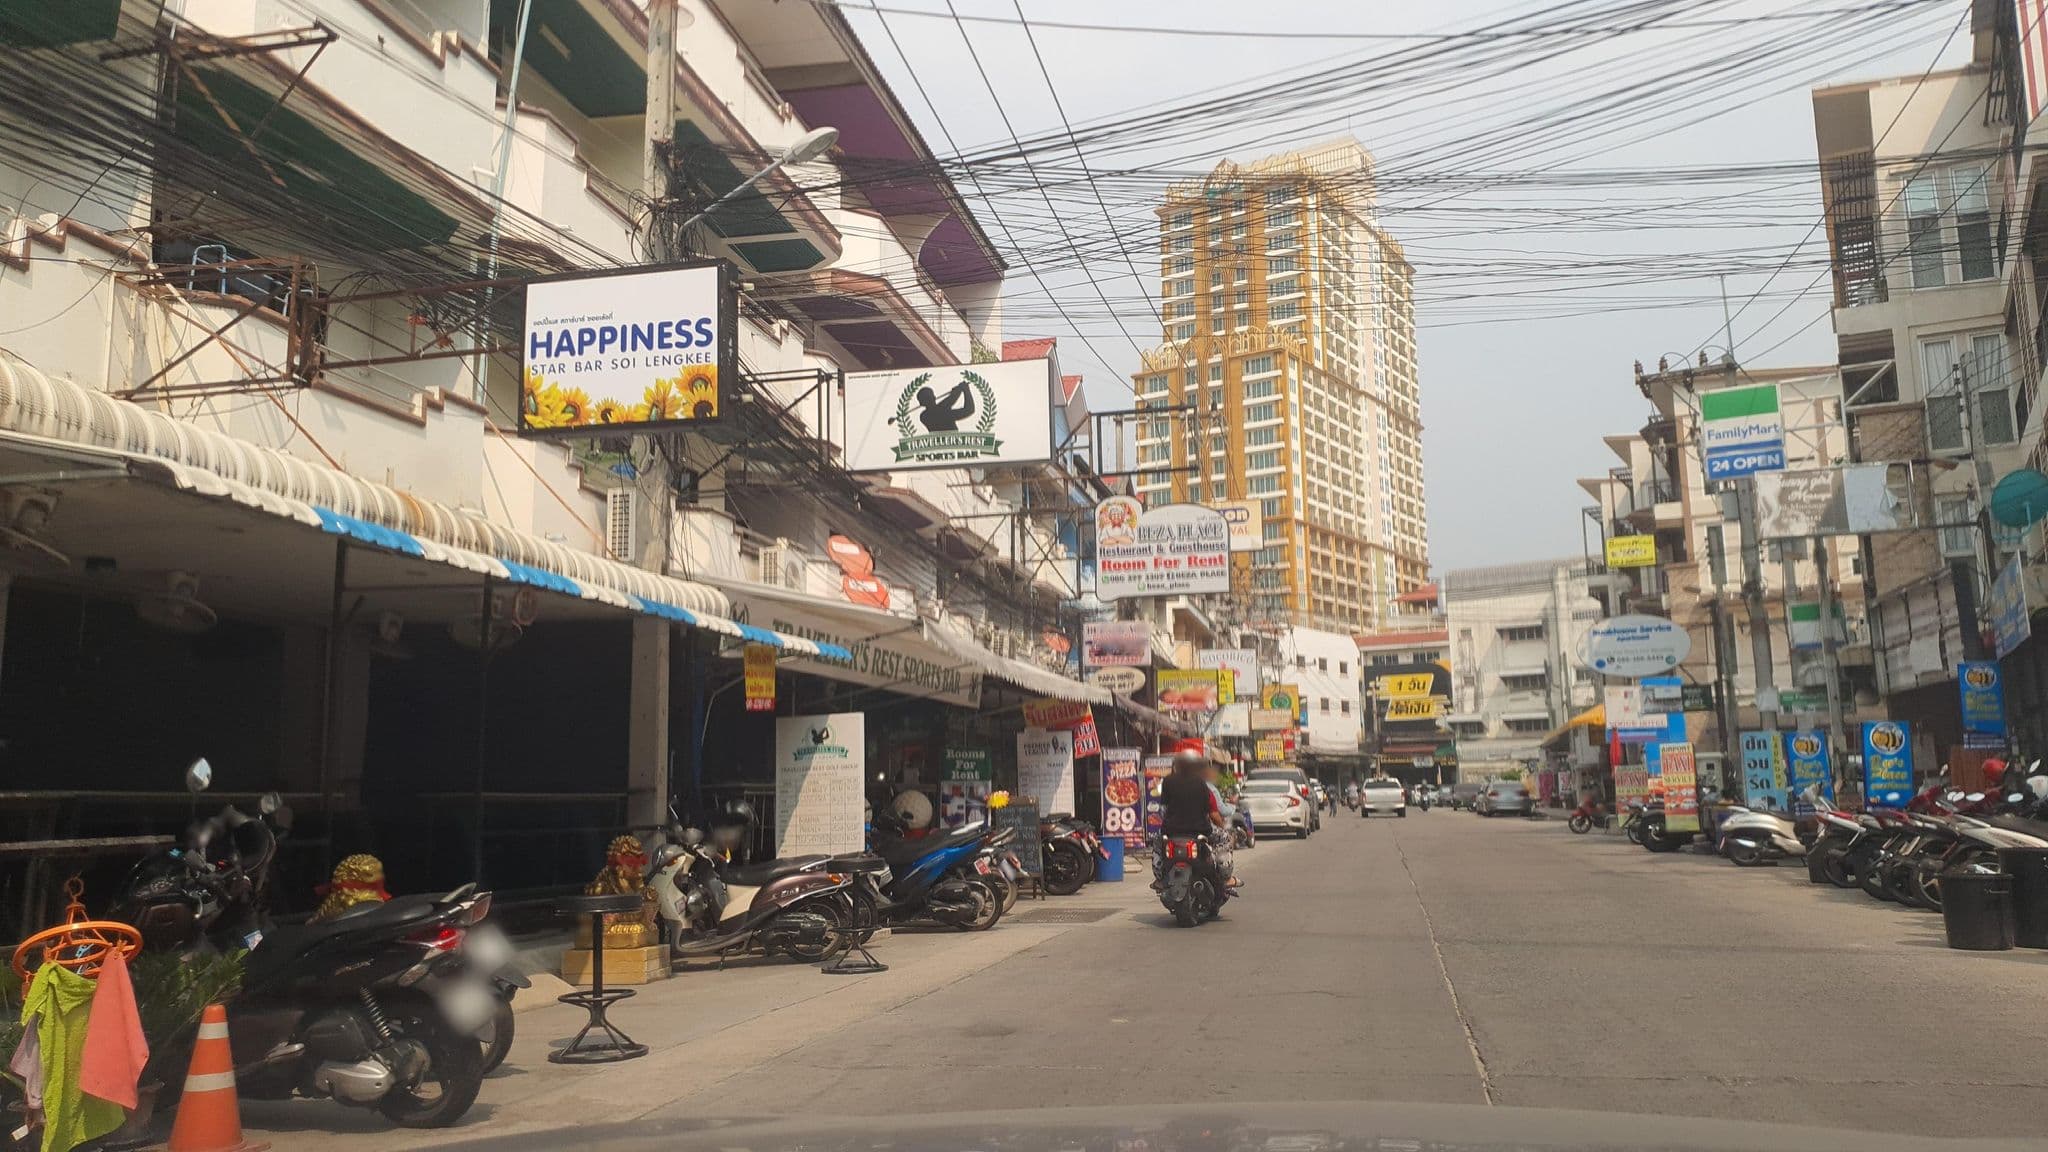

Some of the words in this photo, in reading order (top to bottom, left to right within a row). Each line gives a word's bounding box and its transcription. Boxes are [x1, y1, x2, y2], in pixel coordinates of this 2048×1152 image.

[530, 317, 714, 360] HAPPINESS
[531, 362, 566, 377] STAR
[574, 359, 603, 373] BAR
[610, 357, 637, 370] SOI
[645, 352, 712, 368] LENGKEE
[1706, 423, 1780, 441] FamilyMart
[907, 435, 964, 451] TRAVELLER'S
[964, 436, 986, 447] REST
[915, 451, 956, 462] SPORTS
[957, 450, 979, 460] BAR
[1711, 459, 1730, 473] 24
[1733, 454, 1780, 471] OPEN
[1100, 545, 1153, 558] Restaurant
[1156, 545, 1164, 553] &
[1169, 541, 1226, 553] Guesthouse
[1101, 559, 1146, 571] Room
[1153, 556, 1181, 568] For
[1187, 554, 1224, 567] Rent
[1640, 624, 1672, 633] Service
[871, 648, 903, 680] REST
[903, 656, 942, 690] SPORTS
[942, 667, 961, 695] BAR
[946, 749, 986, 759] Rooms
[1661, 744, 1691, 753] AIRPORT
[955, 760, 976, 770] For
[1662, 753, 1692, 772] TAXI
[951, 770, 981, 780] Rent
[1110, 768, 1137, 779] PIZZA
[1619, 772, 1648, 786] TAXI
[1663, 775, 1691, 783] SERVICE
[1106, 807, 1136, 832] 89
